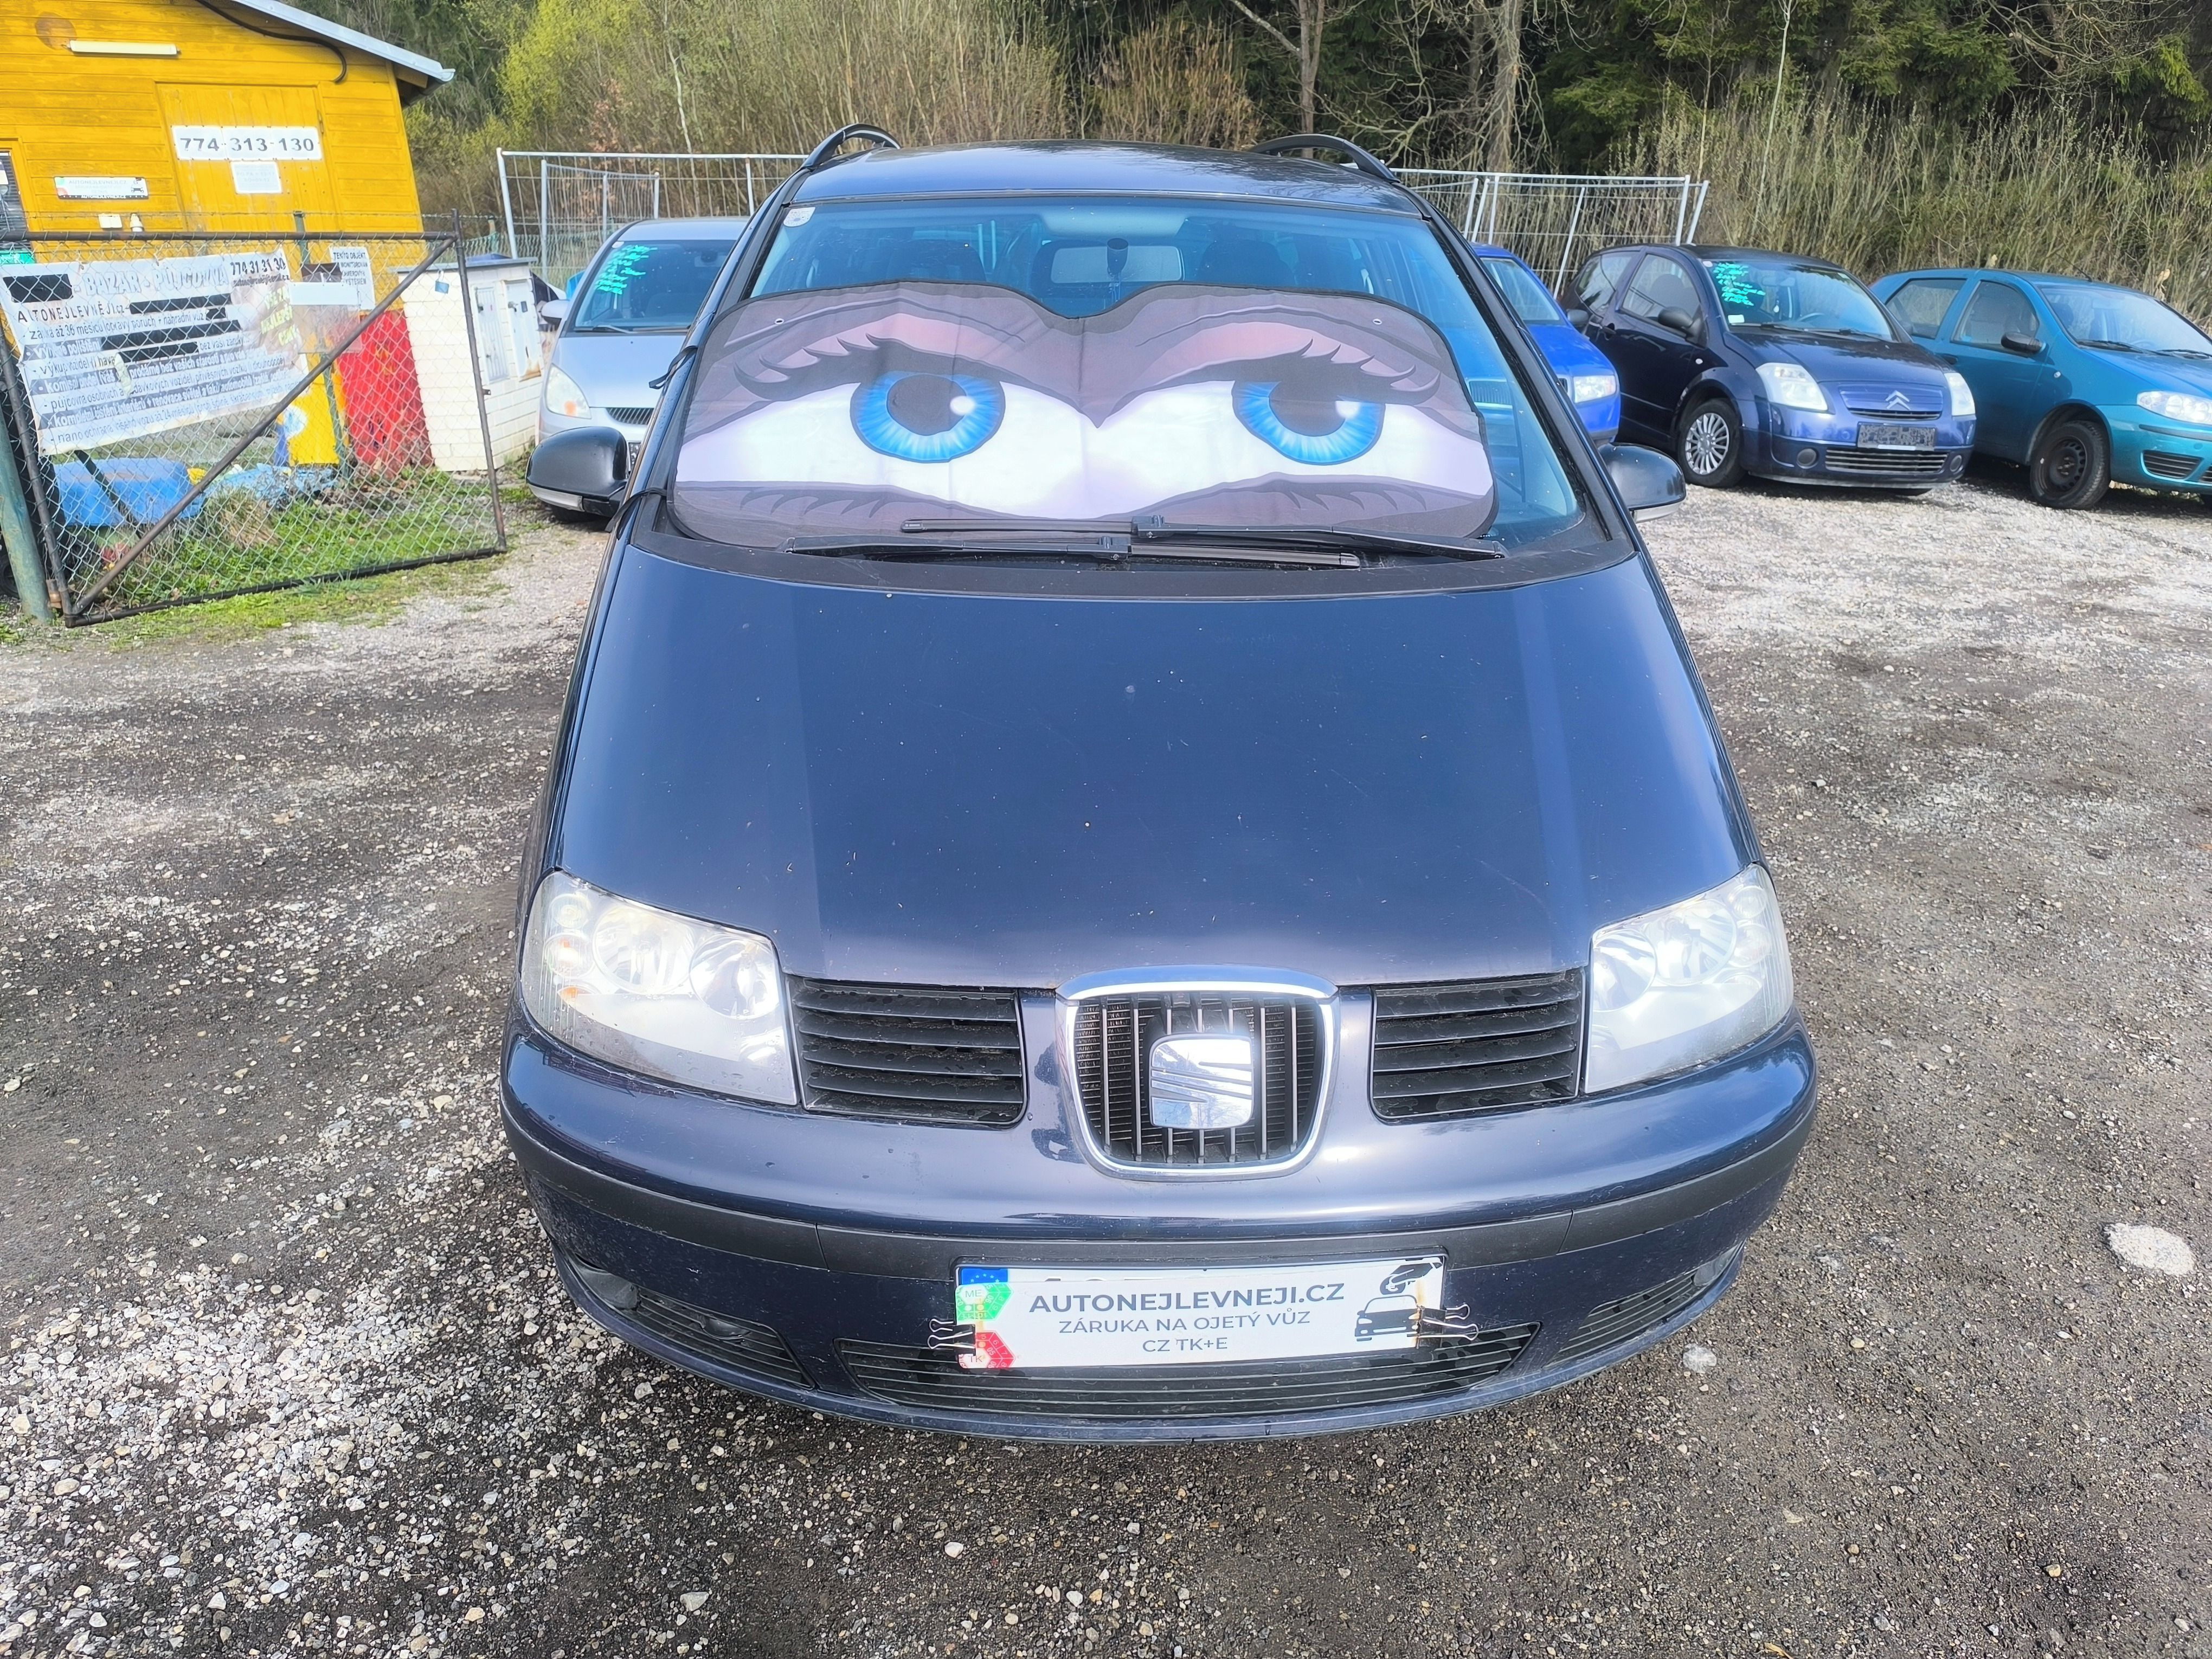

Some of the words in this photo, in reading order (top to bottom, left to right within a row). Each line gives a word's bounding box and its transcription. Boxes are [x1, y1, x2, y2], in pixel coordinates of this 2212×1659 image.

[83, 270, 142, 296] BAZAR
[965, 1289, 982, 1297] ME
[1029, 1283, 1345, 1313] AUTONEJLEVNEJI.CZ
[1059, 1317, 1149, 1334] ZÁRUKA
[1156, 1317, 1188, 1332] NA
[1193, 1311, 1261, 1330] OJETÝ
[1266, 1307, 1311, 1325] VŮZ
[1142, 1339, 1171, 1352] CZ
[1175, 1336, 1228, 1352] TK+E
